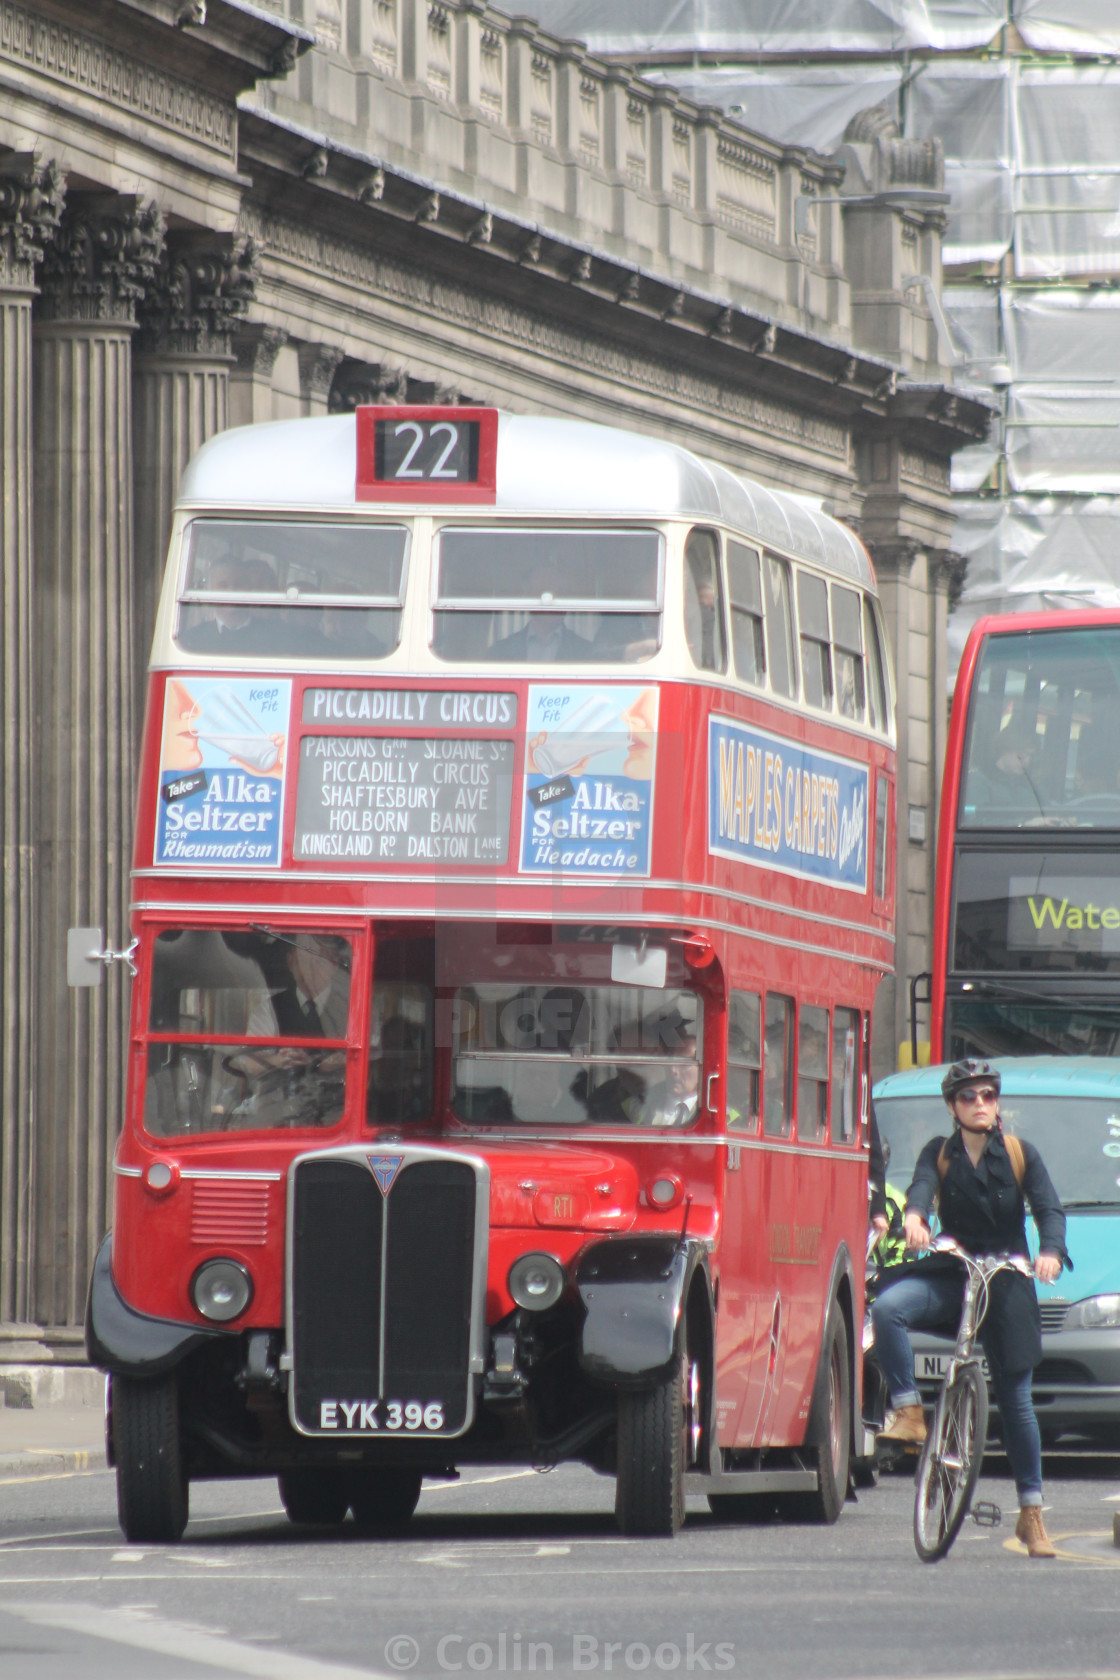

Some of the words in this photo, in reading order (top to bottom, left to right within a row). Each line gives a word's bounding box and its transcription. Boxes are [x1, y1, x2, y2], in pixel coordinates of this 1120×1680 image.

[394, 421, 458, 478] 22
[249, 688, 279, 702] Keep
[260, 701, 279, 713] Fit
[313, 690, 428, 721] PICCADILLY
[440, 693, 511, 723] CIRCUS
[537, 695, 571, 709] Keep
[542, 709, 561, 723] Fit
[305, 738, 376, 759] PARSONS
[424, 740, 484, 761] SLOANE
[322, 761, 419, 784] PICCADILLY
[433, 763, 489, 785] CIRCUS
[203, 774, 277, 803] Alka-
[321, 785, 440, 809] SHAFTESBURY
[454, 788, 488, 810] AVE
[571, 782, 646, 812] Alka-
[719, 736, 783, 853] MAPLES
[785, 765, 840, 861] CARPETS
[165, 804, 273, 832] Seltzer
[329, 810, 408, 833] HOLBORN
[430, 811, 477, 834] BANK
[532, 809, 642, 840] Seltzer
[165, 831, 188, 840] FOR
[301, 834, 373, 857] KINGSLAND
[407, 836, 468, 859] DALSTON
[531, 838, 555, 846] FOR
[162, 840, 273, 859] Rheumatism
[534, 846, 639, 868] Headache
[320, 1403, 379, 1429] EYK
[385, 1403, 444, 1430] 396
